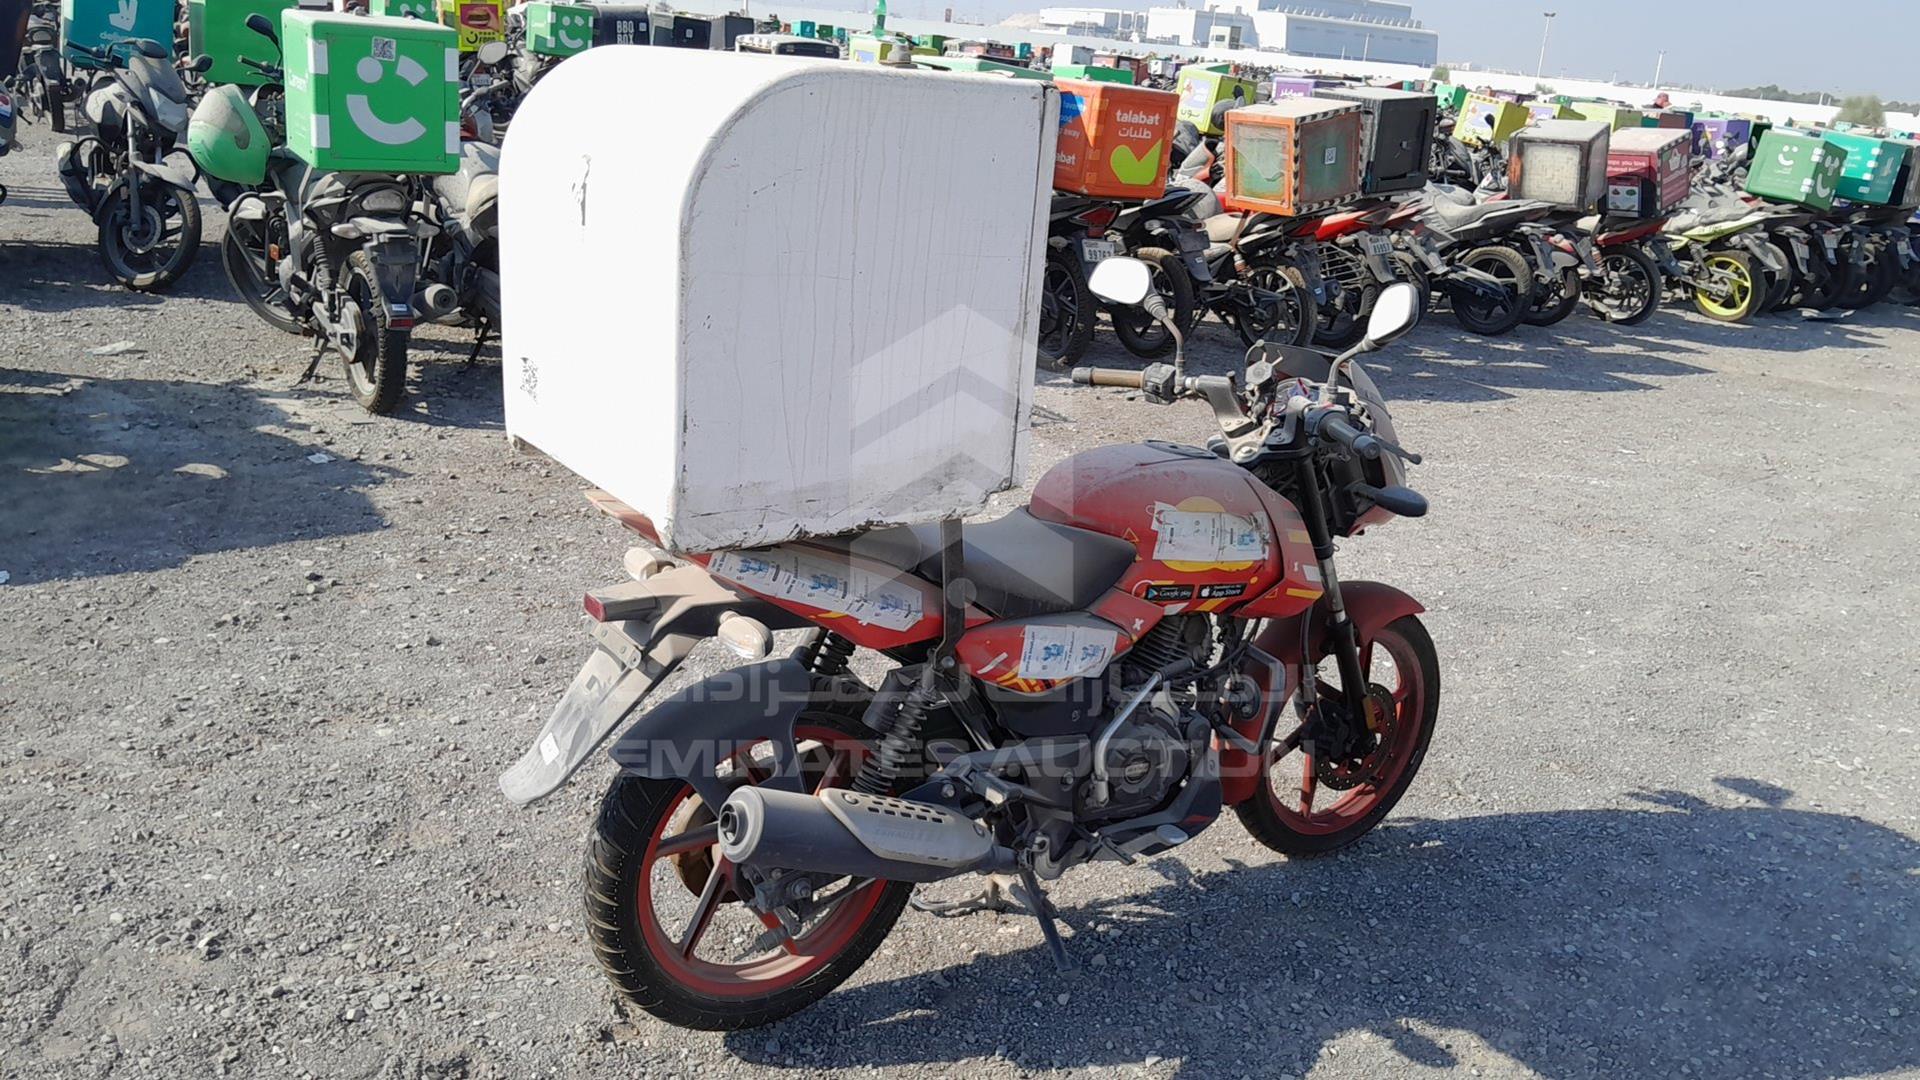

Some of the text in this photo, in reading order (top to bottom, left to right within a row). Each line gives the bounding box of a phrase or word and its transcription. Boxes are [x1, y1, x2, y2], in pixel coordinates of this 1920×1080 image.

[616, 20, 634, 33] BBQ
[1116, 109, 1160, 125] talabat
[1118, 126, 1152, 140] طلبات
[1211, 589, 1225, 597] App
